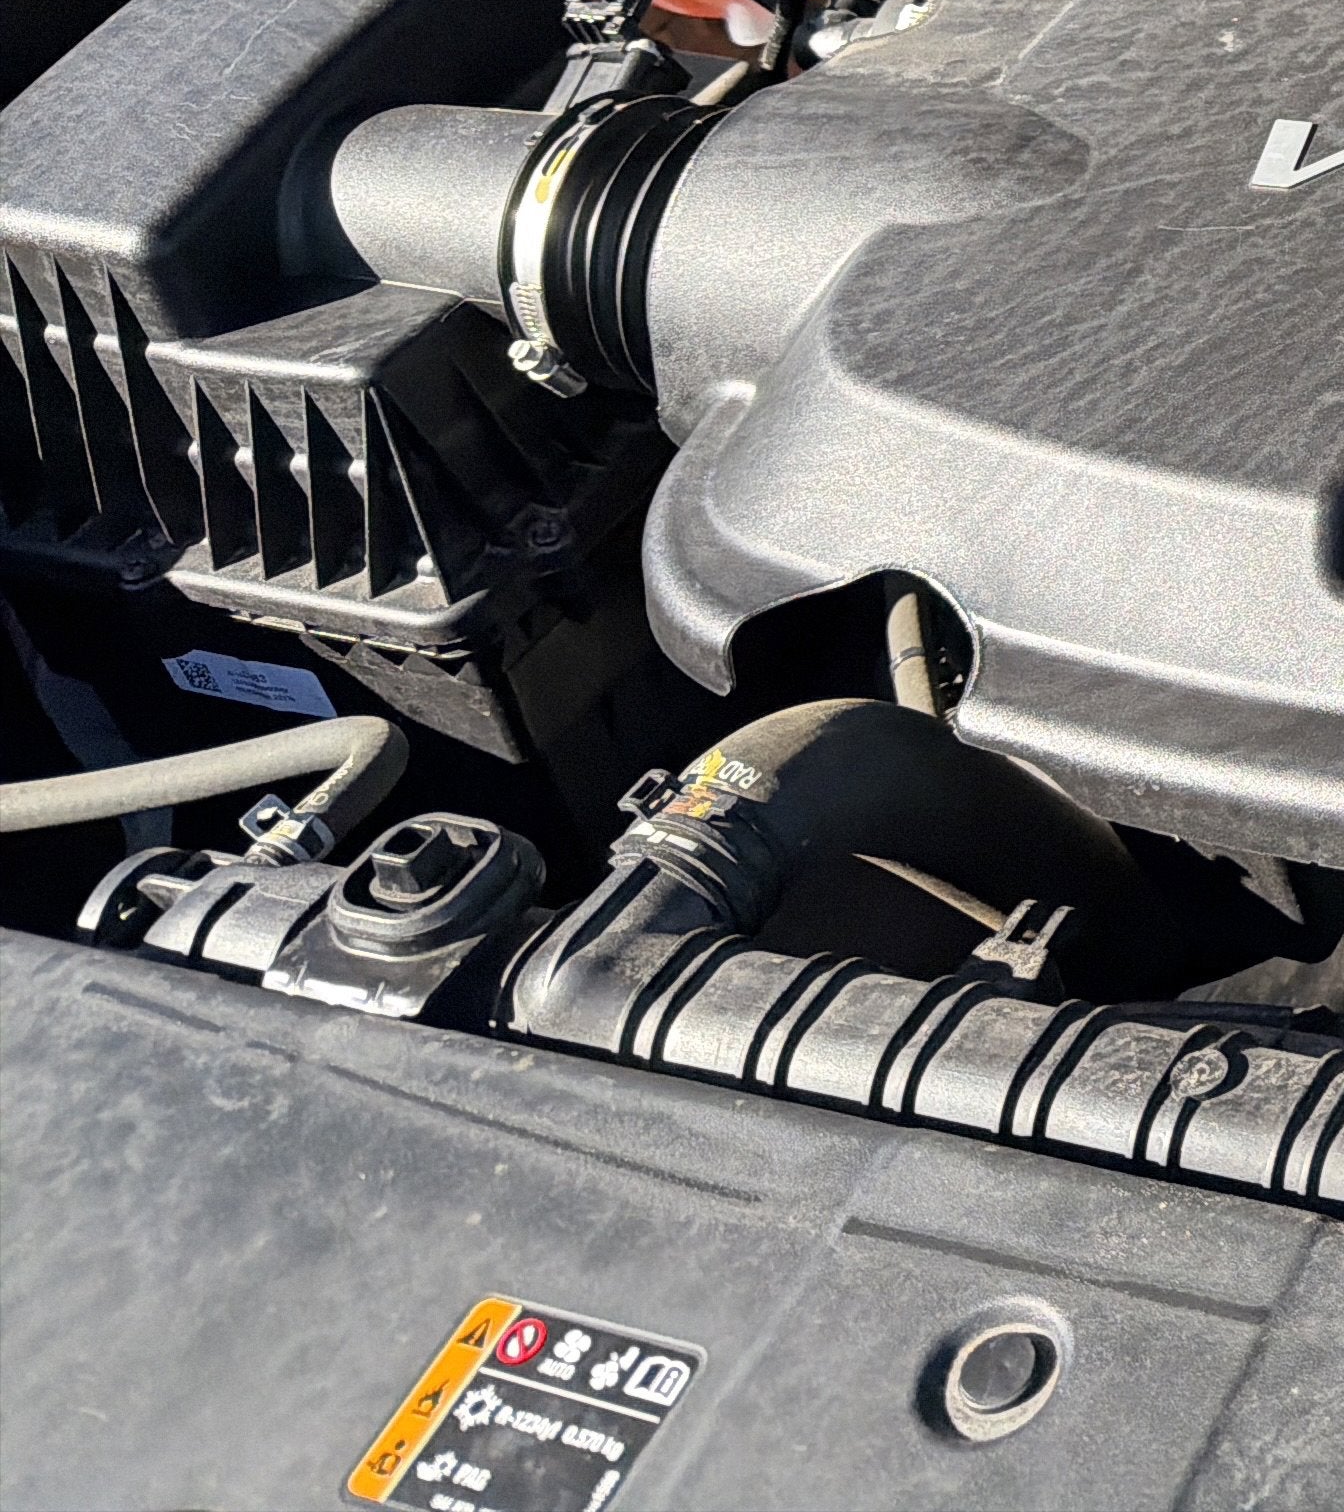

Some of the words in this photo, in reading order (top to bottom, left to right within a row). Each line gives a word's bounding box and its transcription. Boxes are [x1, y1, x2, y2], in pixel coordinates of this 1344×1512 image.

[718, 760, 762, 790] RAD
[537, 1358, 576, 1380] AUTO
[452, 1463, 492, 1491] PAG
